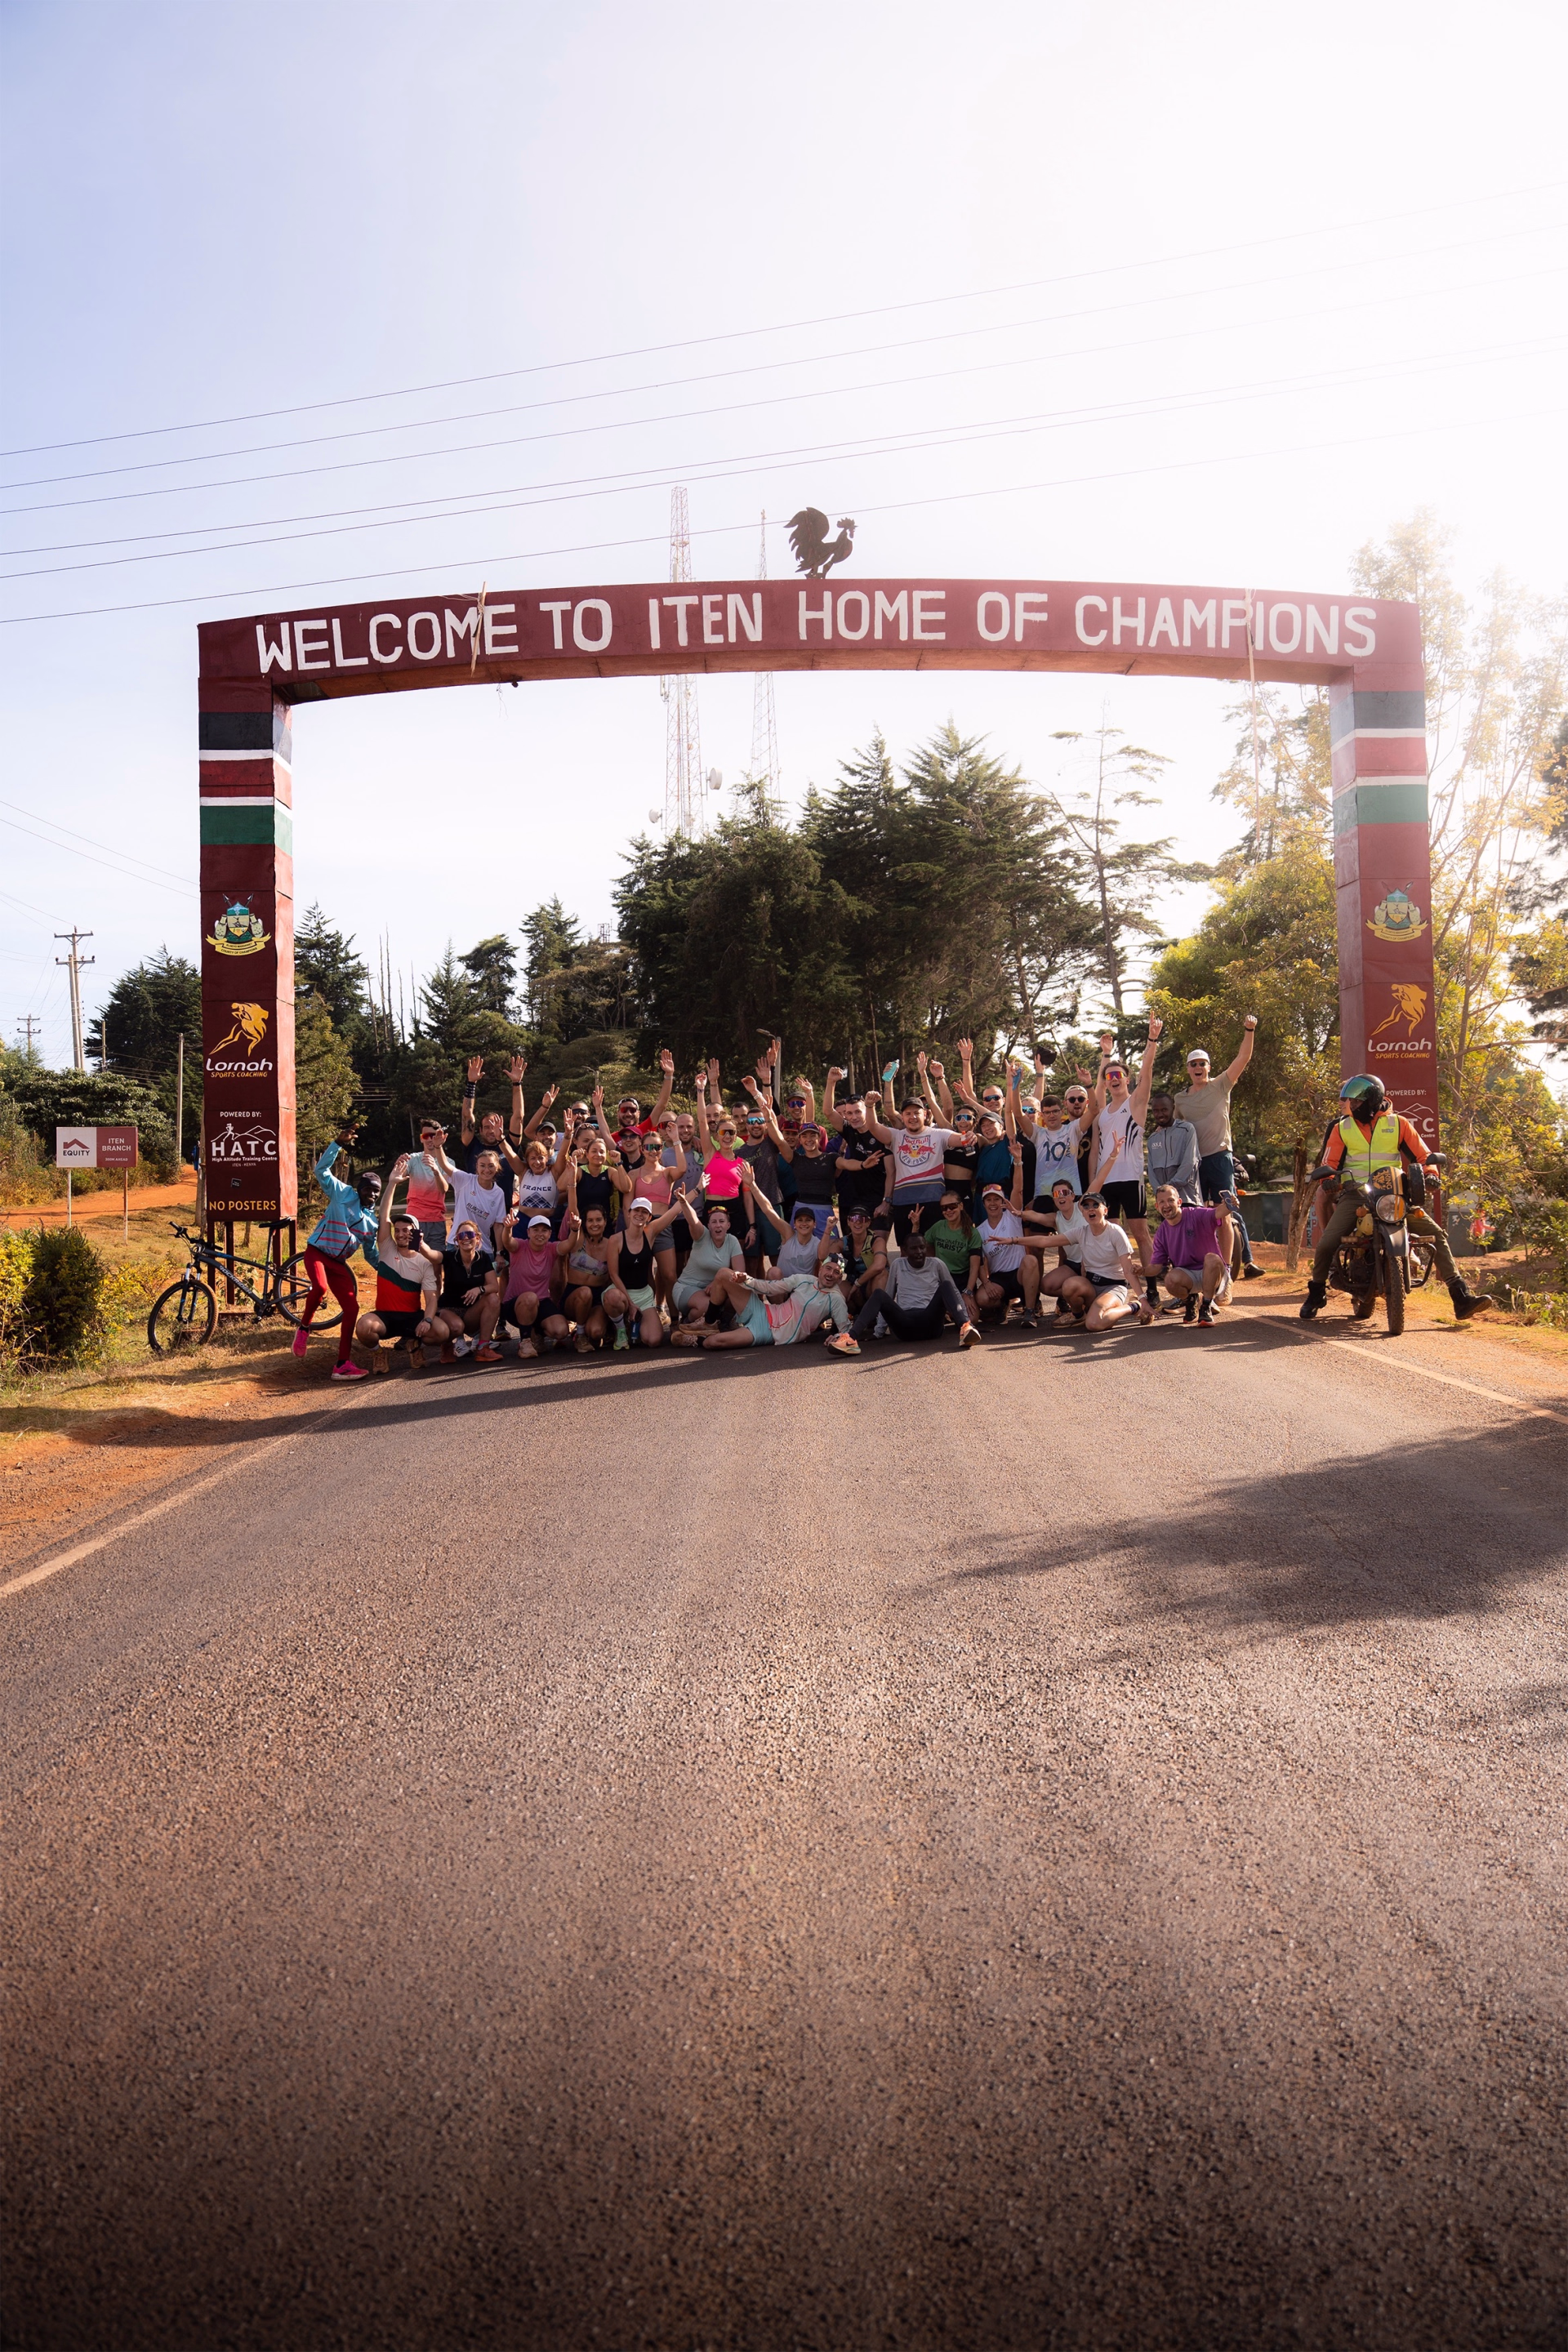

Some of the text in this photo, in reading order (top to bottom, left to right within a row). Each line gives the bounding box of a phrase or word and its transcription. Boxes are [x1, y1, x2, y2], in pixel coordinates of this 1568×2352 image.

[256, 590, 1376, 673] WELCOME TO ITEN HOME OF CHAMPIONS
[1368, 1038, 1432, 1052] Lornah
[206, 1058, 273, 1071] Lornah
[1408, 1118, 1434, 1132] TC
[212, 1140, 276, 1156] HATC
[1043, 1141, 1066, 1161] 10
[209, 1201, 276, 1210] NO POSTERS
